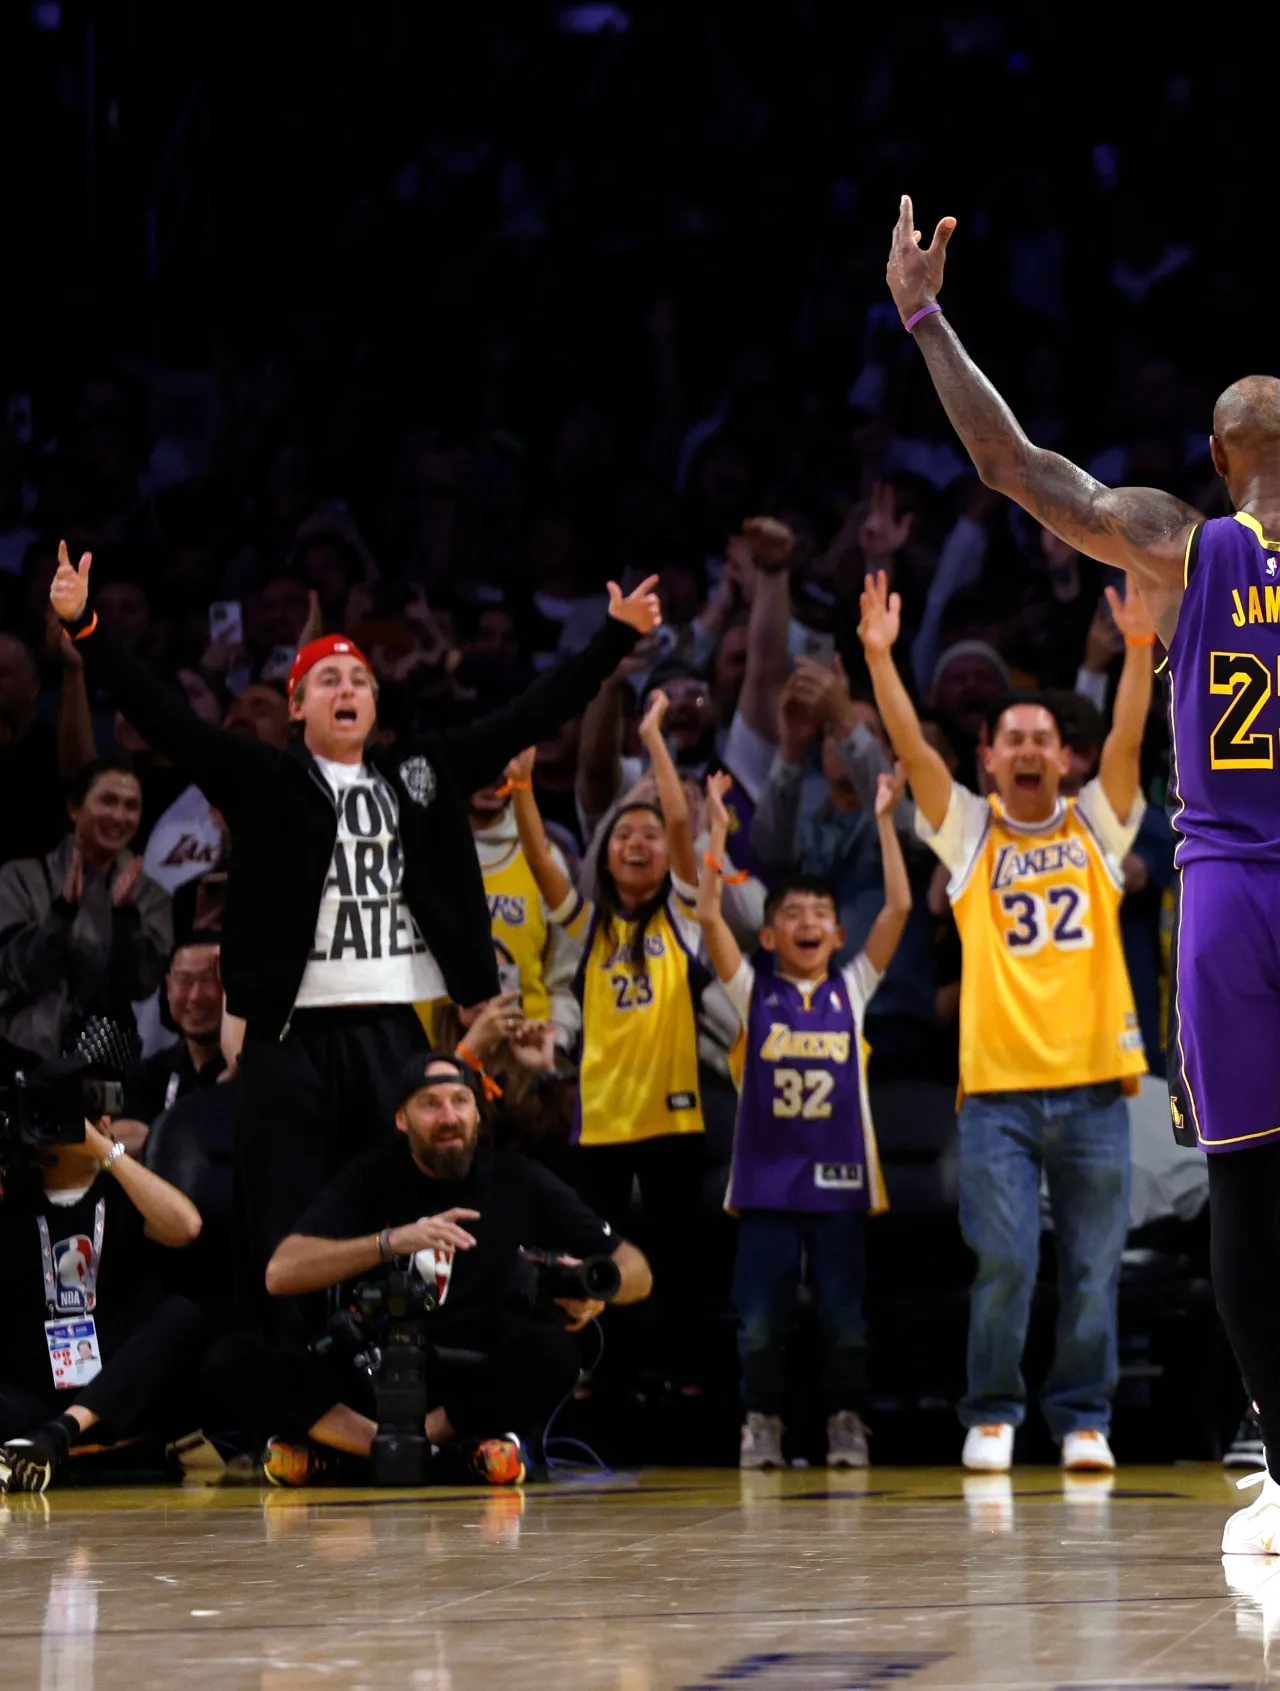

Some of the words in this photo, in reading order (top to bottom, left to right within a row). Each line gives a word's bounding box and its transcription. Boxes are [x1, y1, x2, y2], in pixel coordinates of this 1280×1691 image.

[992, 839, 1089, 891] LAKERS
[1001, 885, 1094, 956] 32
[611, 973, 653, 1009] 23
[772, 1067, 835, 1119] 32
